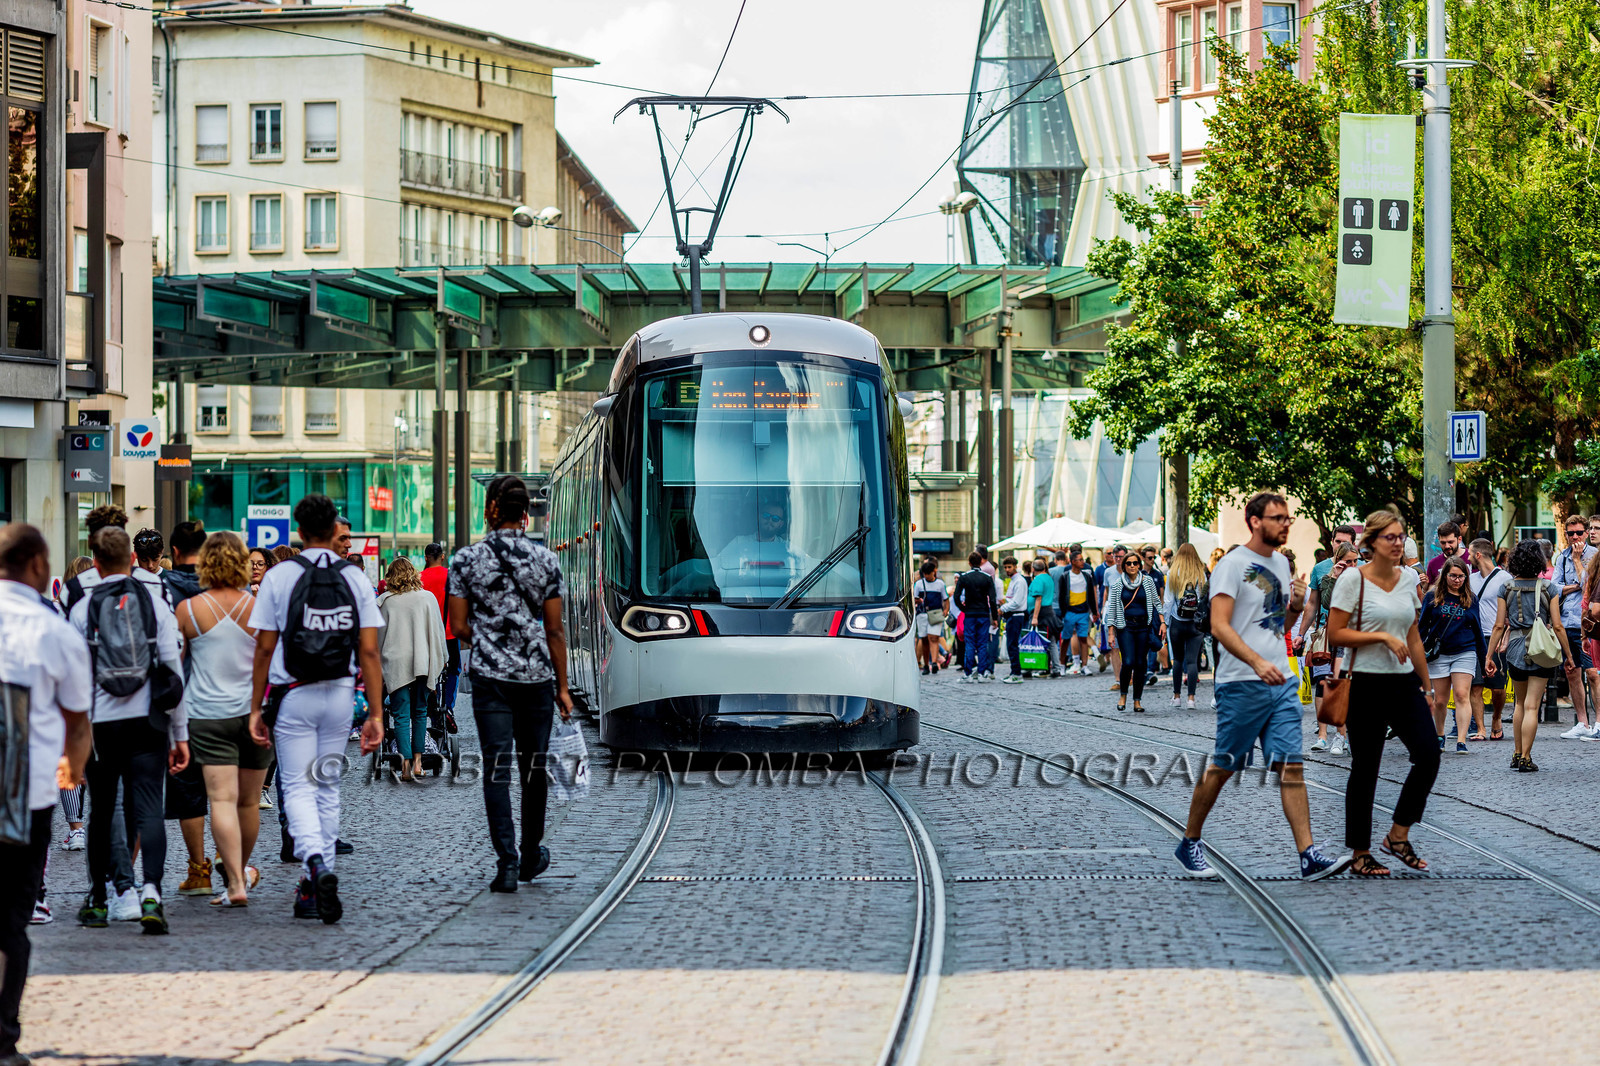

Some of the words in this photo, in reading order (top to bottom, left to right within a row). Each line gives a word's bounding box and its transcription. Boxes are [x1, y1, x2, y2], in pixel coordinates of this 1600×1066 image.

[1365, 132, 1391, 155] ici
[1350, 160, 1405, 176] toilettes
[1342, 175, 1412, 195] publiques
[122, 448, 157, 459] bouygues
[256, 525, 280, 548] P
[303, 602, 354, 632] VANS
